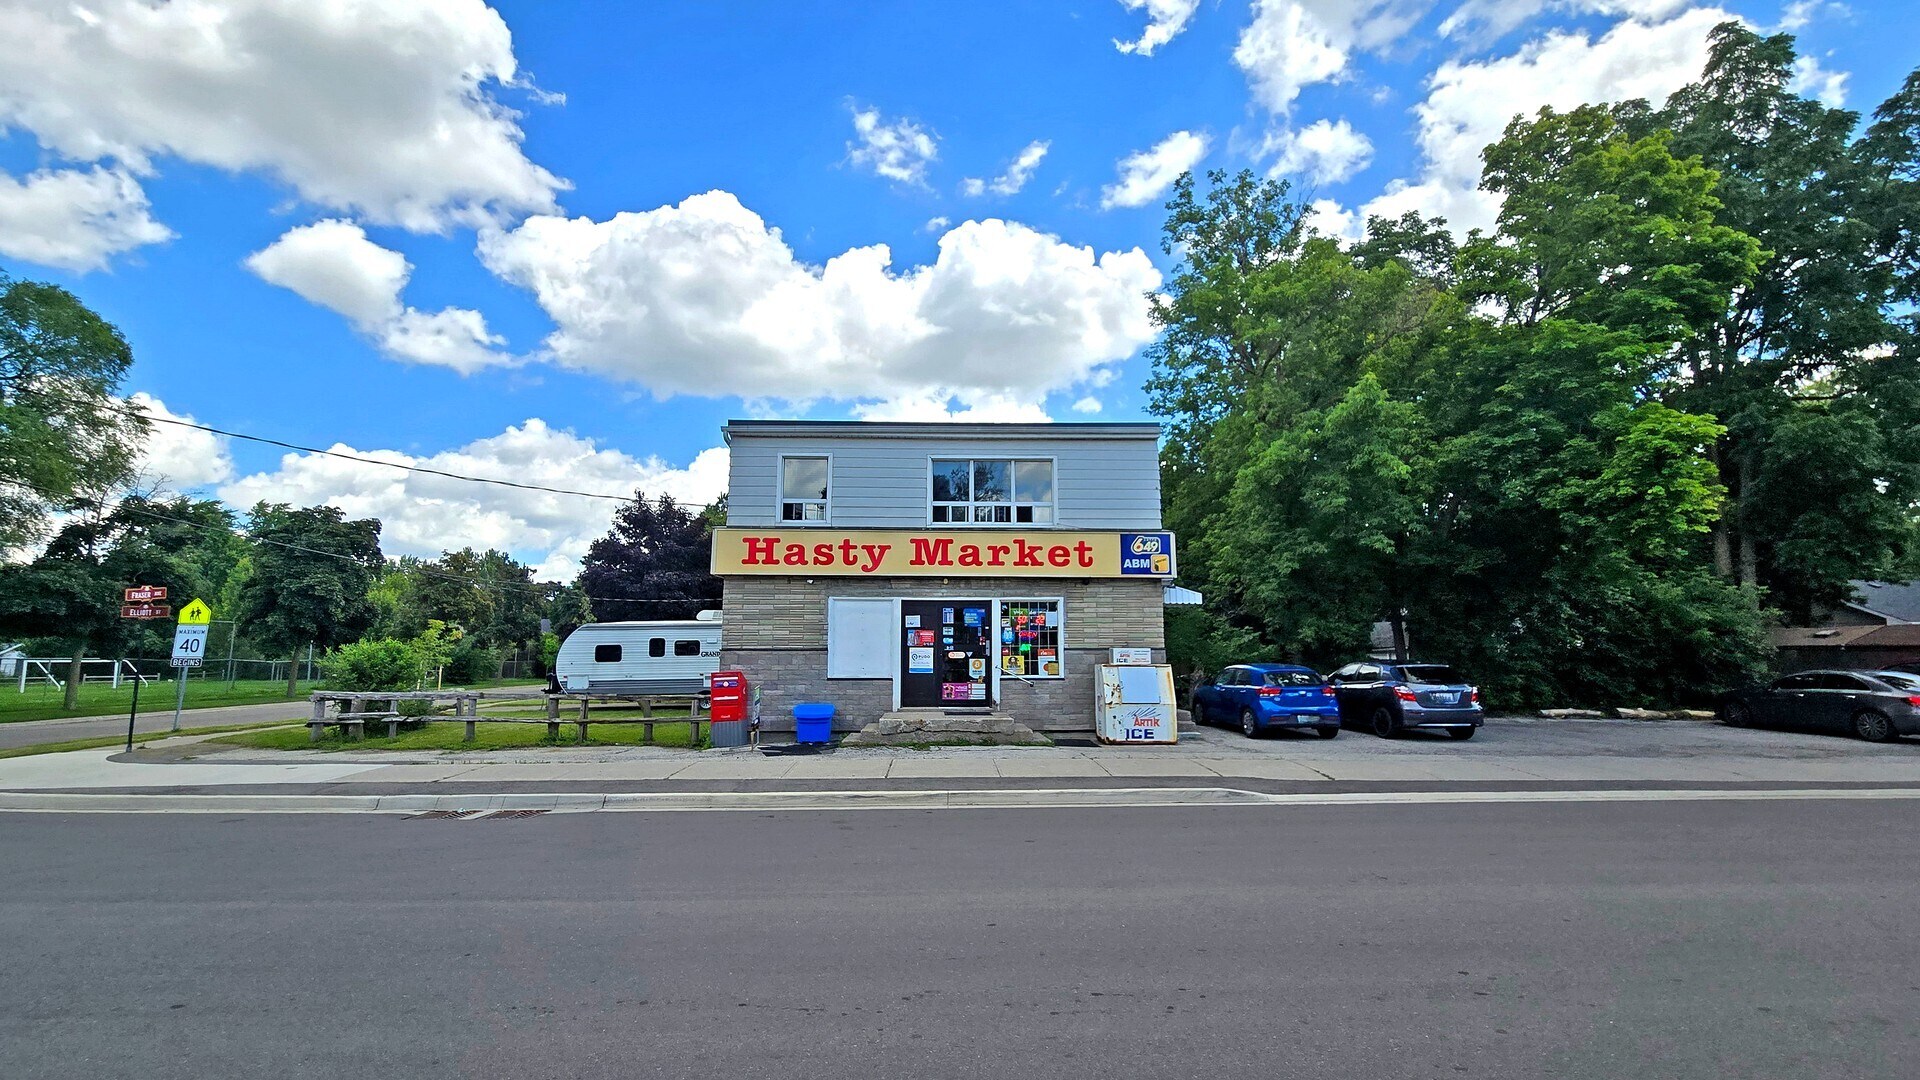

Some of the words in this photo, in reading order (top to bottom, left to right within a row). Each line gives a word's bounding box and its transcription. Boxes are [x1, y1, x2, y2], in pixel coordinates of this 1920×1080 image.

[741, 537, 892, 573] Hasty
[909, 538, 1094, 568] Market
[1123, 558, 1150, 569] ABM
[131, 591, 152, 599] FRASER
[129, 608, 152, 616] ELLIOTT
[179, 638, 200, 653] 40
[172, 658, 200, 666] BEGINS
[1125, 728, 1155, 739] ICE
